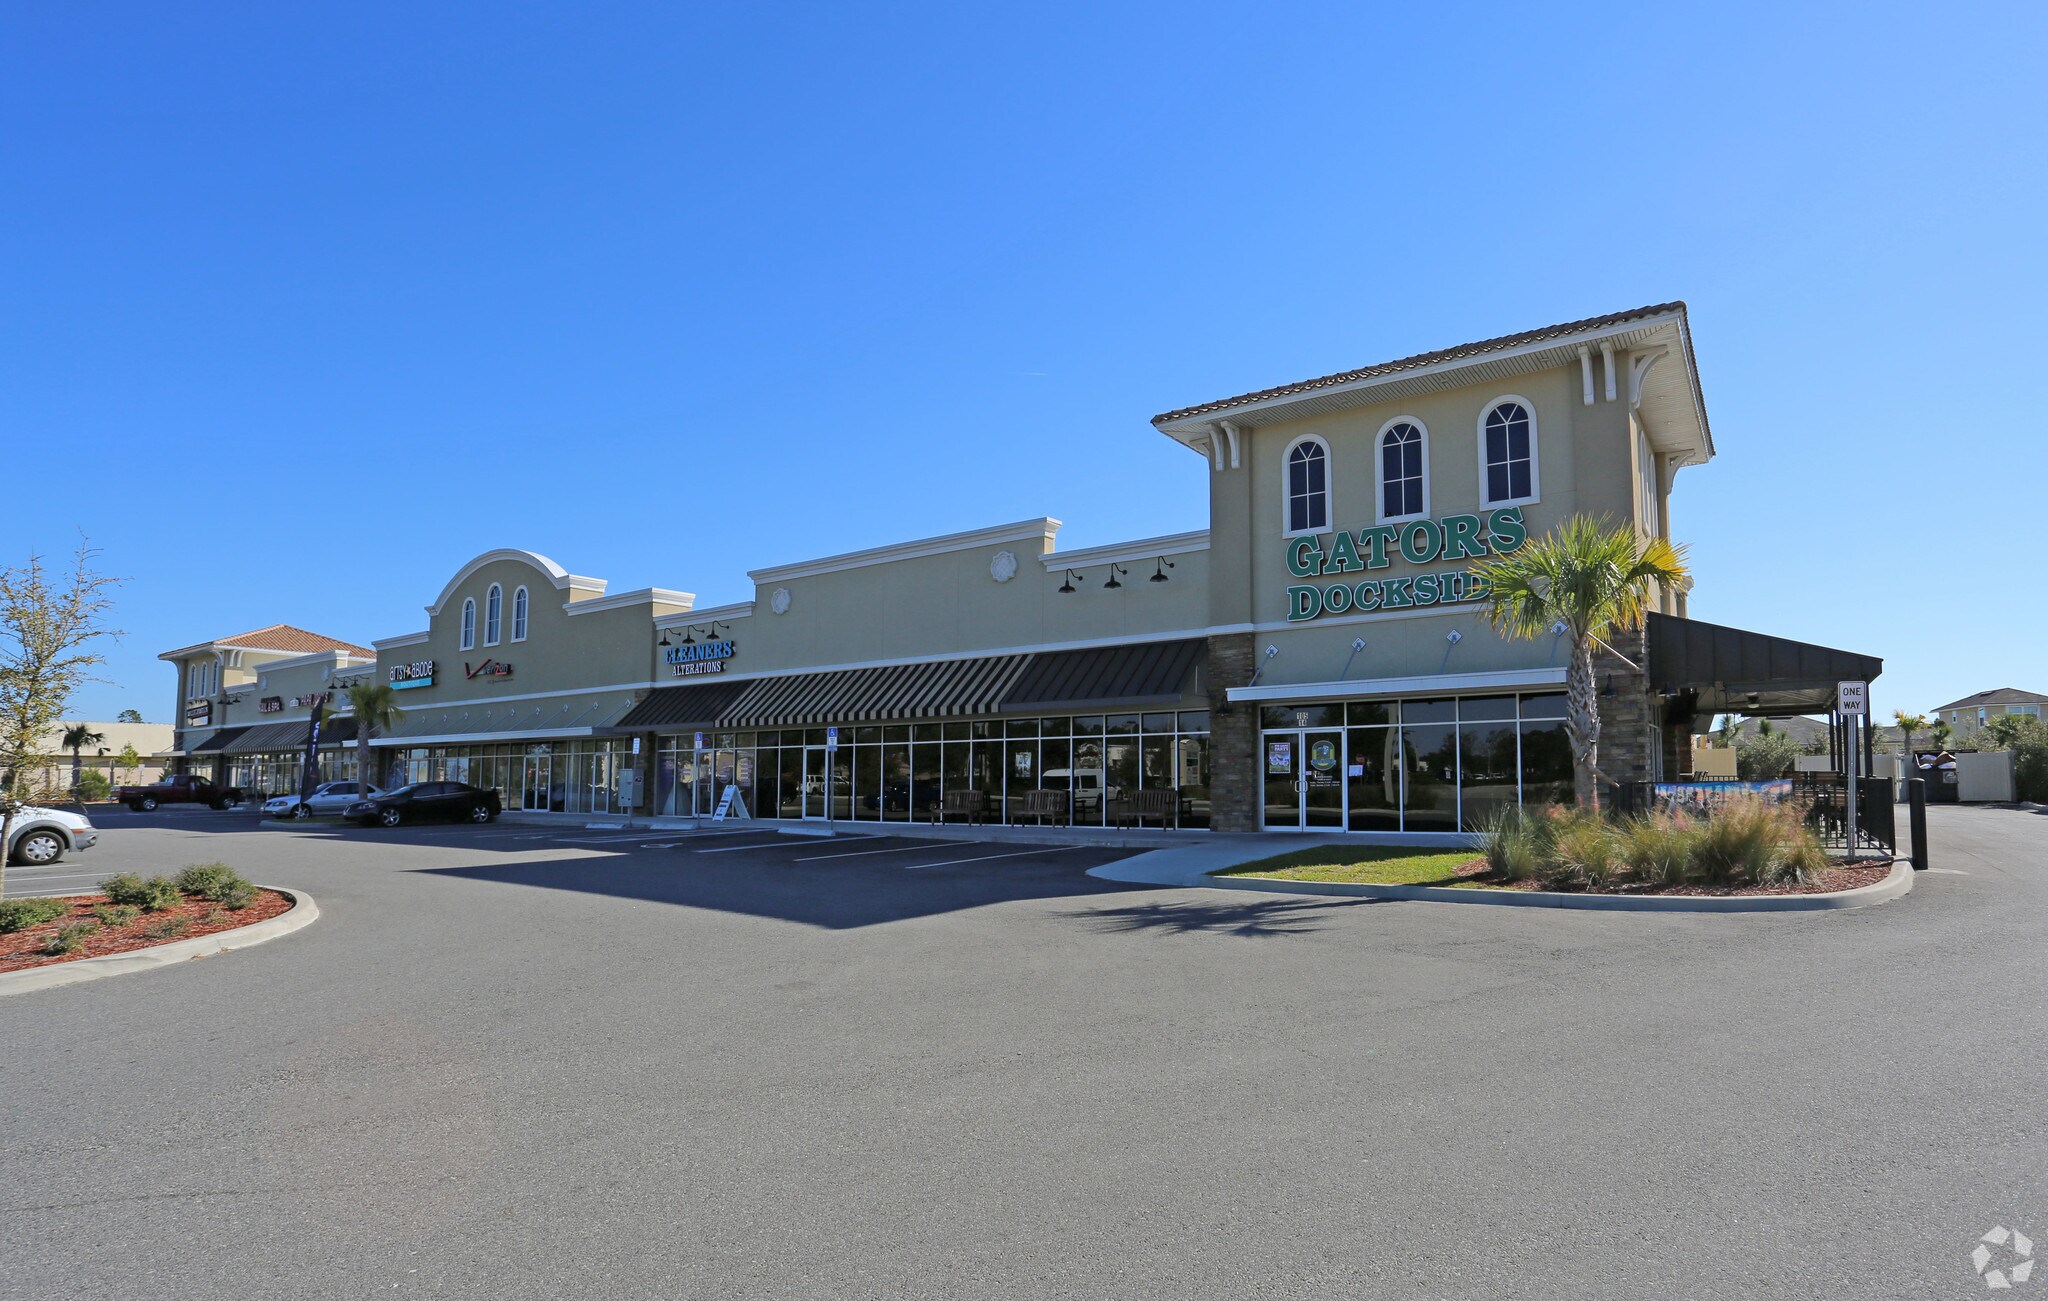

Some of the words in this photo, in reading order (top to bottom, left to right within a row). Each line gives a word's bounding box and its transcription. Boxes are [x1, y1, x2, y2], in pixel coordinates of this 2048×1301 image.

[1286, 506, 1527, 577] GATORS
[665, 641, 732, 664] CLEANERS
[672, 661, 721, 676] ALTERATIONS
[1843, 688, 1861, 696] ONE
[1844, 701, 1861, 709] WAY
